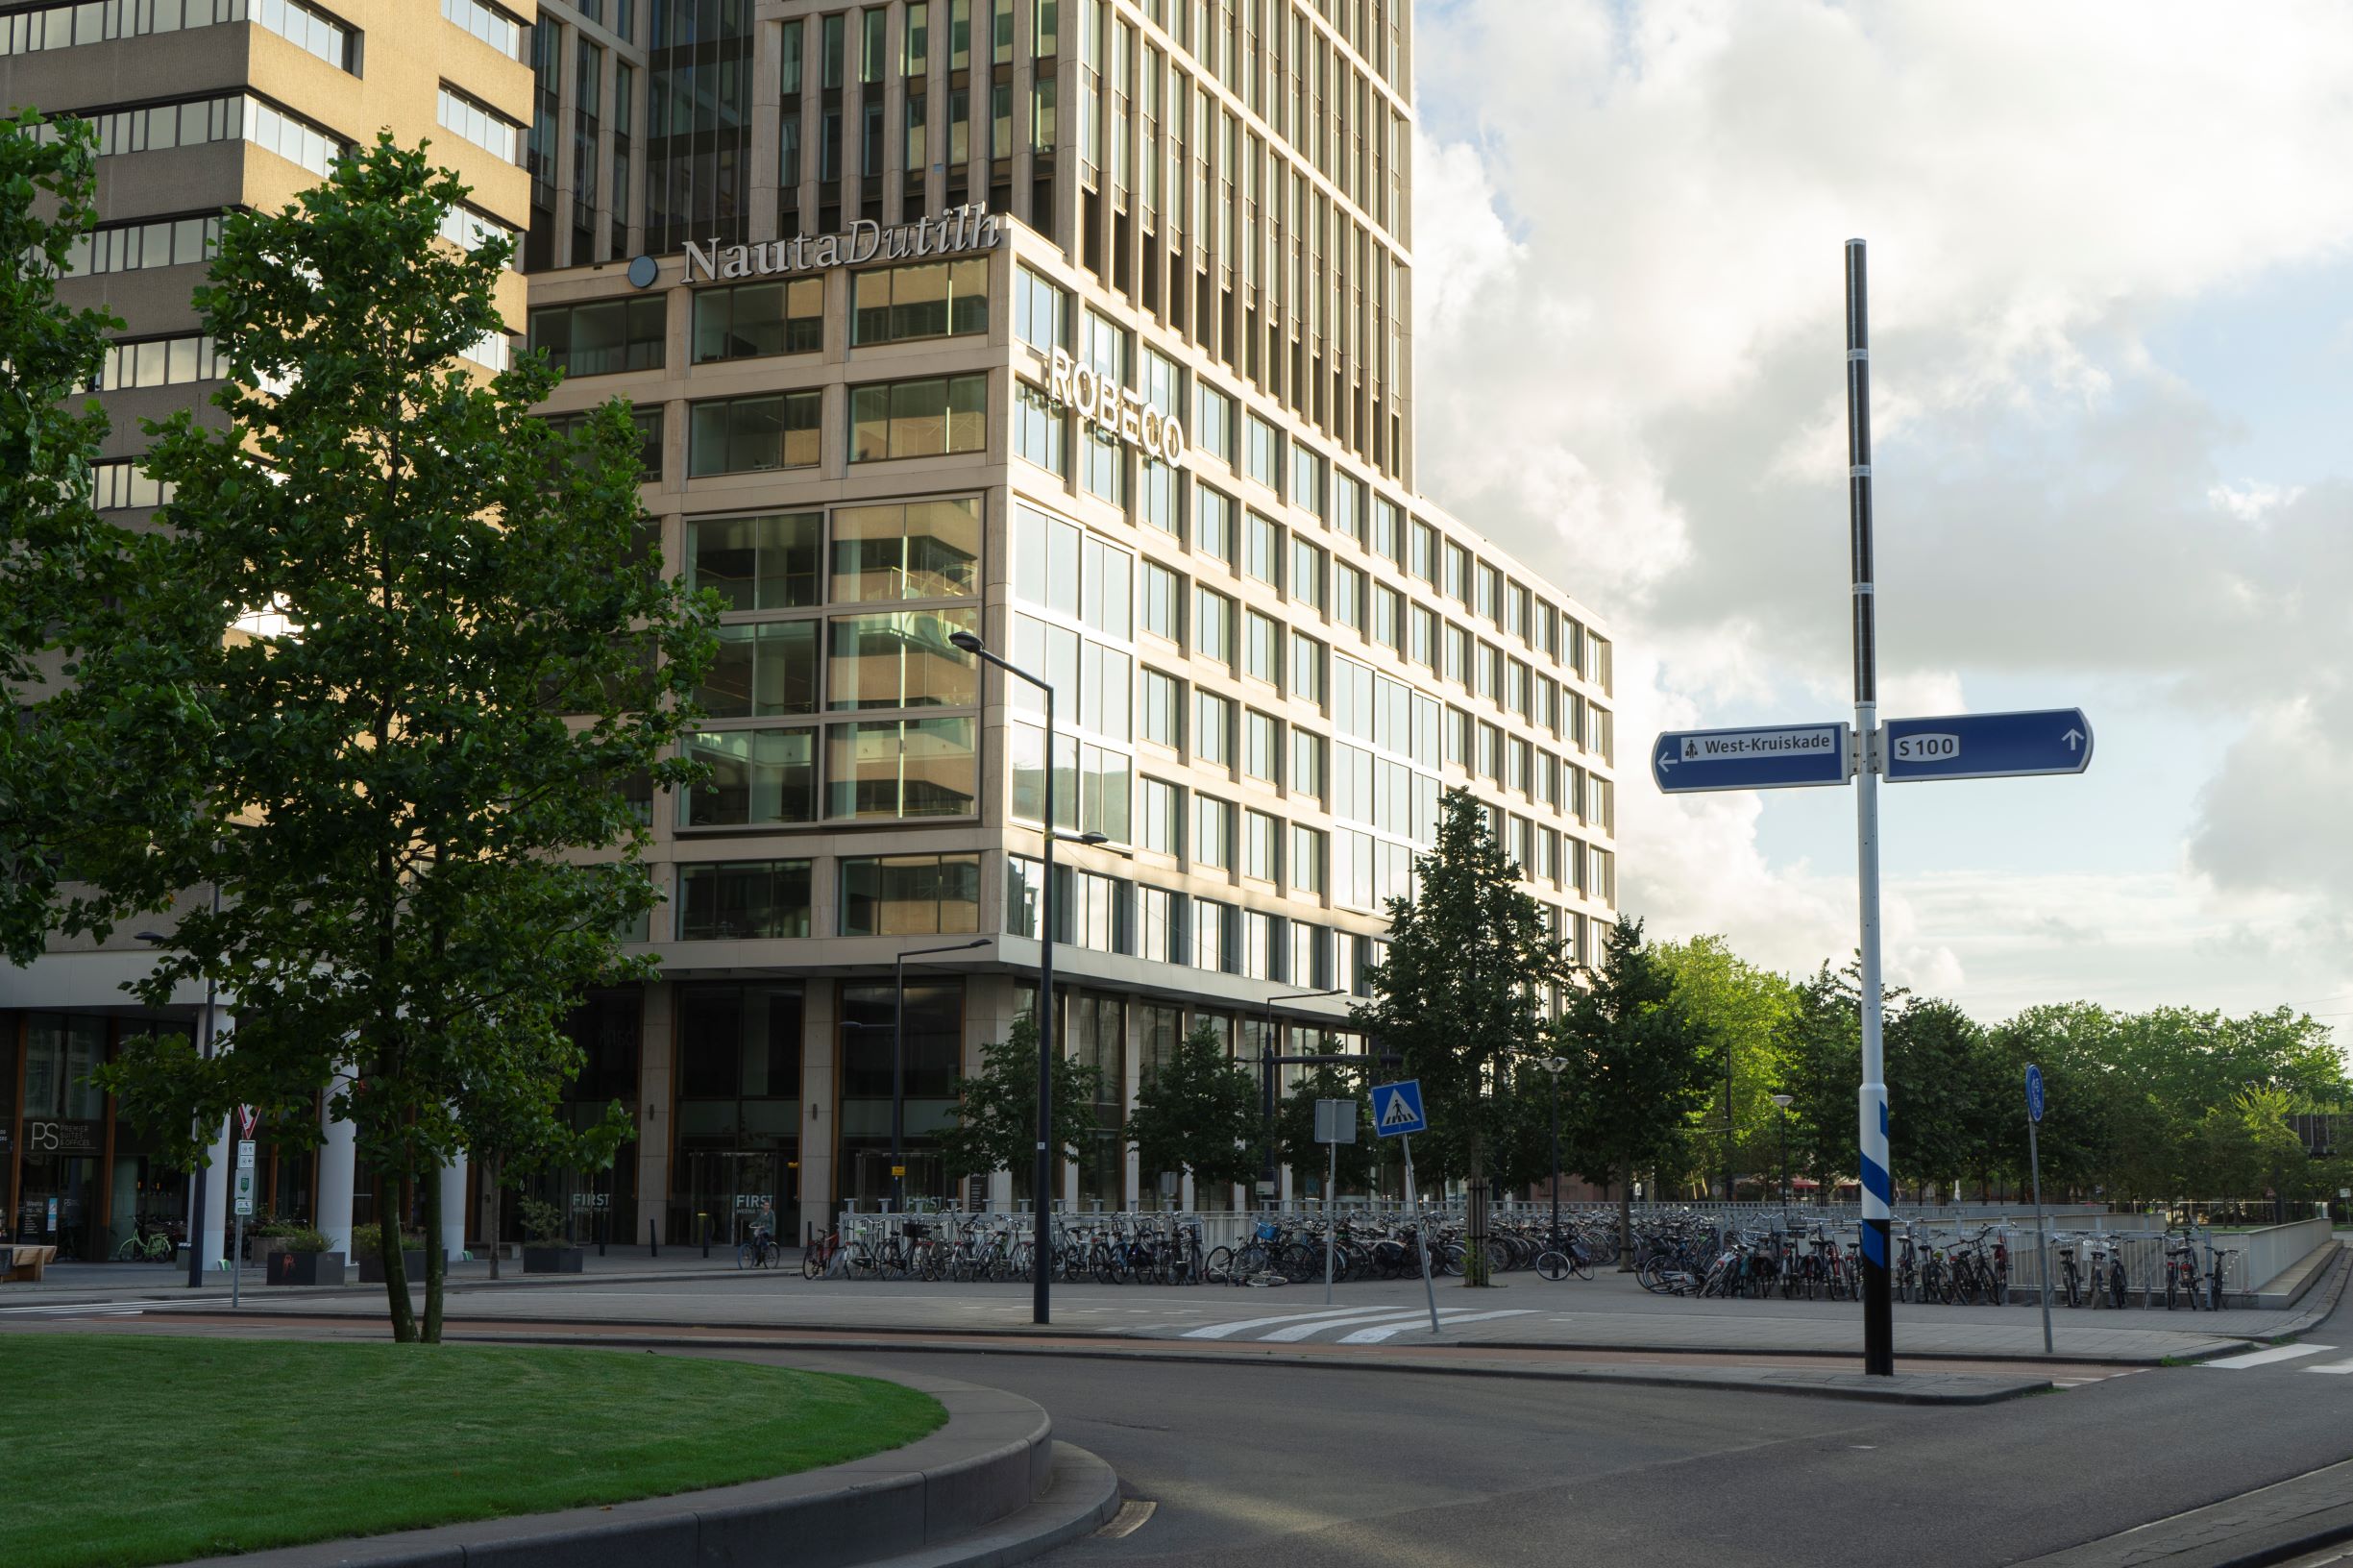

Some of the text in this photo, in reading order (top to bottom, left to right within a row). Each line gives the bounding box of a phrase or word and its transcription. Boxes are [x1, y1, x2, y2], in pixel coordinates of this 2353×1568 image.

[680, 200, 1000, 283] NautaDutilh
[1047, 343, 1185, 469] ROBECO
[1704, 734, 1830, 754] West-Kruiskade
[31, 1122, 59, 1150] PS
[573, 1193, 610, 1206] FIRST
